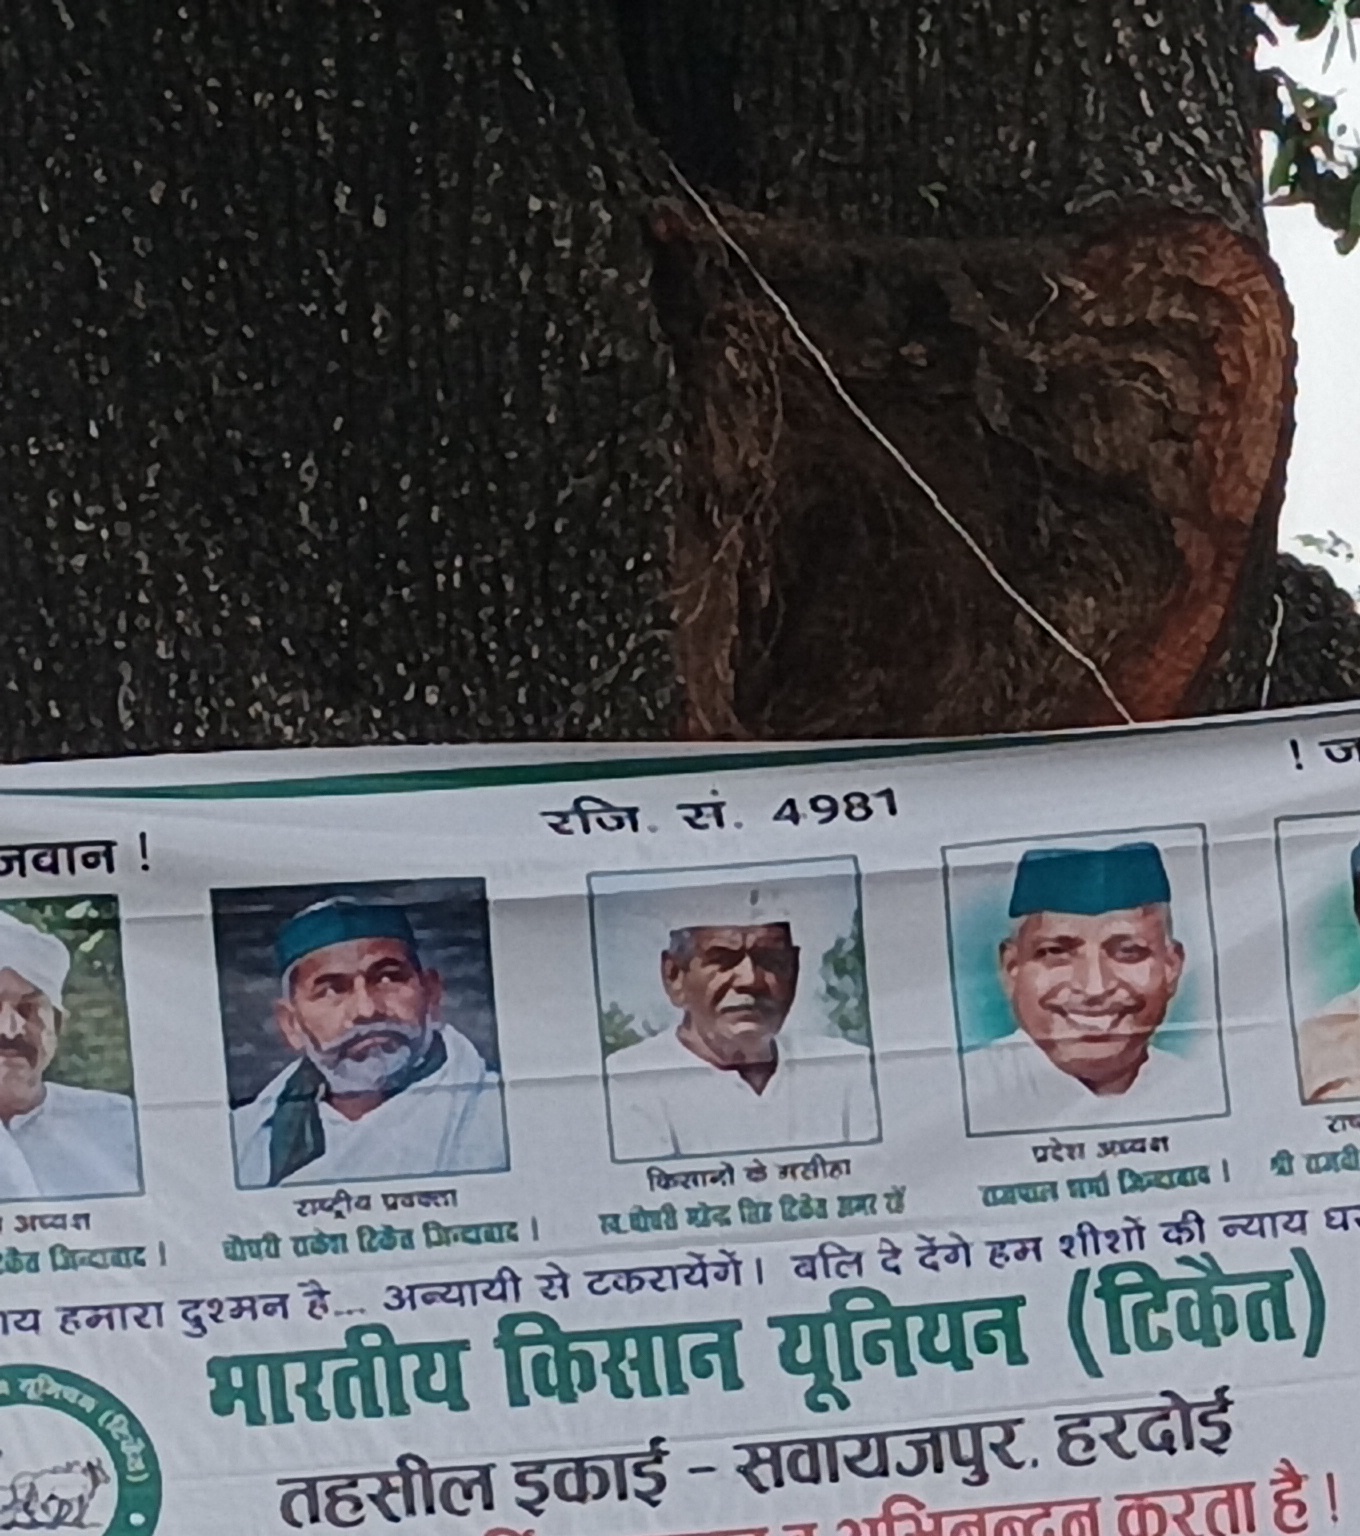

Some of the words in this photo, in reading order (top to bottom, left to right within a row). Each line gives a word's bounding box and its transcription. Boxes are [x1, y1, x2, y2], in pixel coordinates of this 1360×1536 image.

[772, 787, 898, 827] 4981
[56, 1301, 165, 1336] हमारा
[178, 1292, 290, 1339] दुश्मन
[383, 1265, 522, 1312] अन्यायी
[535, 1261, 570, 1301] से
[789, 1241, 863, 1282] बलि
[877, 1237, 902, 1276] दे
[985, 1236, 1043, 1270] हम
[1158, 1208, 1206, 1246] की
[1218, 1208, 1308, 1240] न्याय
[206, 1321, 471, 1428] भारतीय
[494, 1310, 745, 1408] किसान
[766, 1286, 1030, 1413] यूनियन
[1066, 1245, 1326, 1379] (टिकैत)
[276, 1452, 497, 1529] तहसील
[510, 1435, 671, 1517] इकाई
[1055, 1384, 1235, 1470] हरदोई
